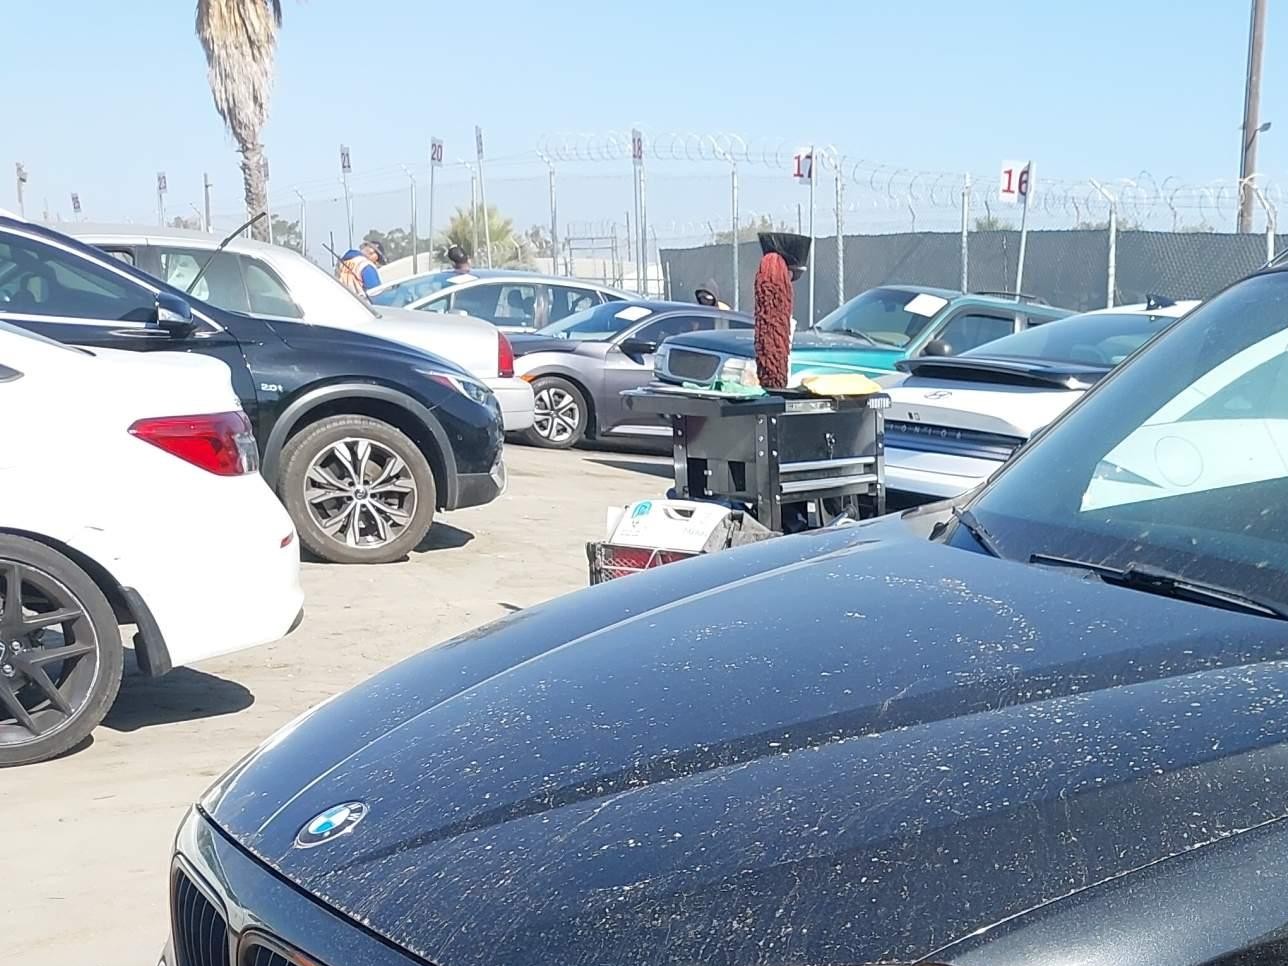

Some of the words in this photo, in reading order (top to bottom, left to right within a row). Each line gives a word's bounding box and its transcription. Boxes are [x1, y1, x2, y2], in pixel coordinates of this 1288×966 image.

[431, 143, 443, 162] 20
[632, 137, 643, 160] 18
[793, 154, 814, 179] 17
[1002, 168, 1029, 196] 16
